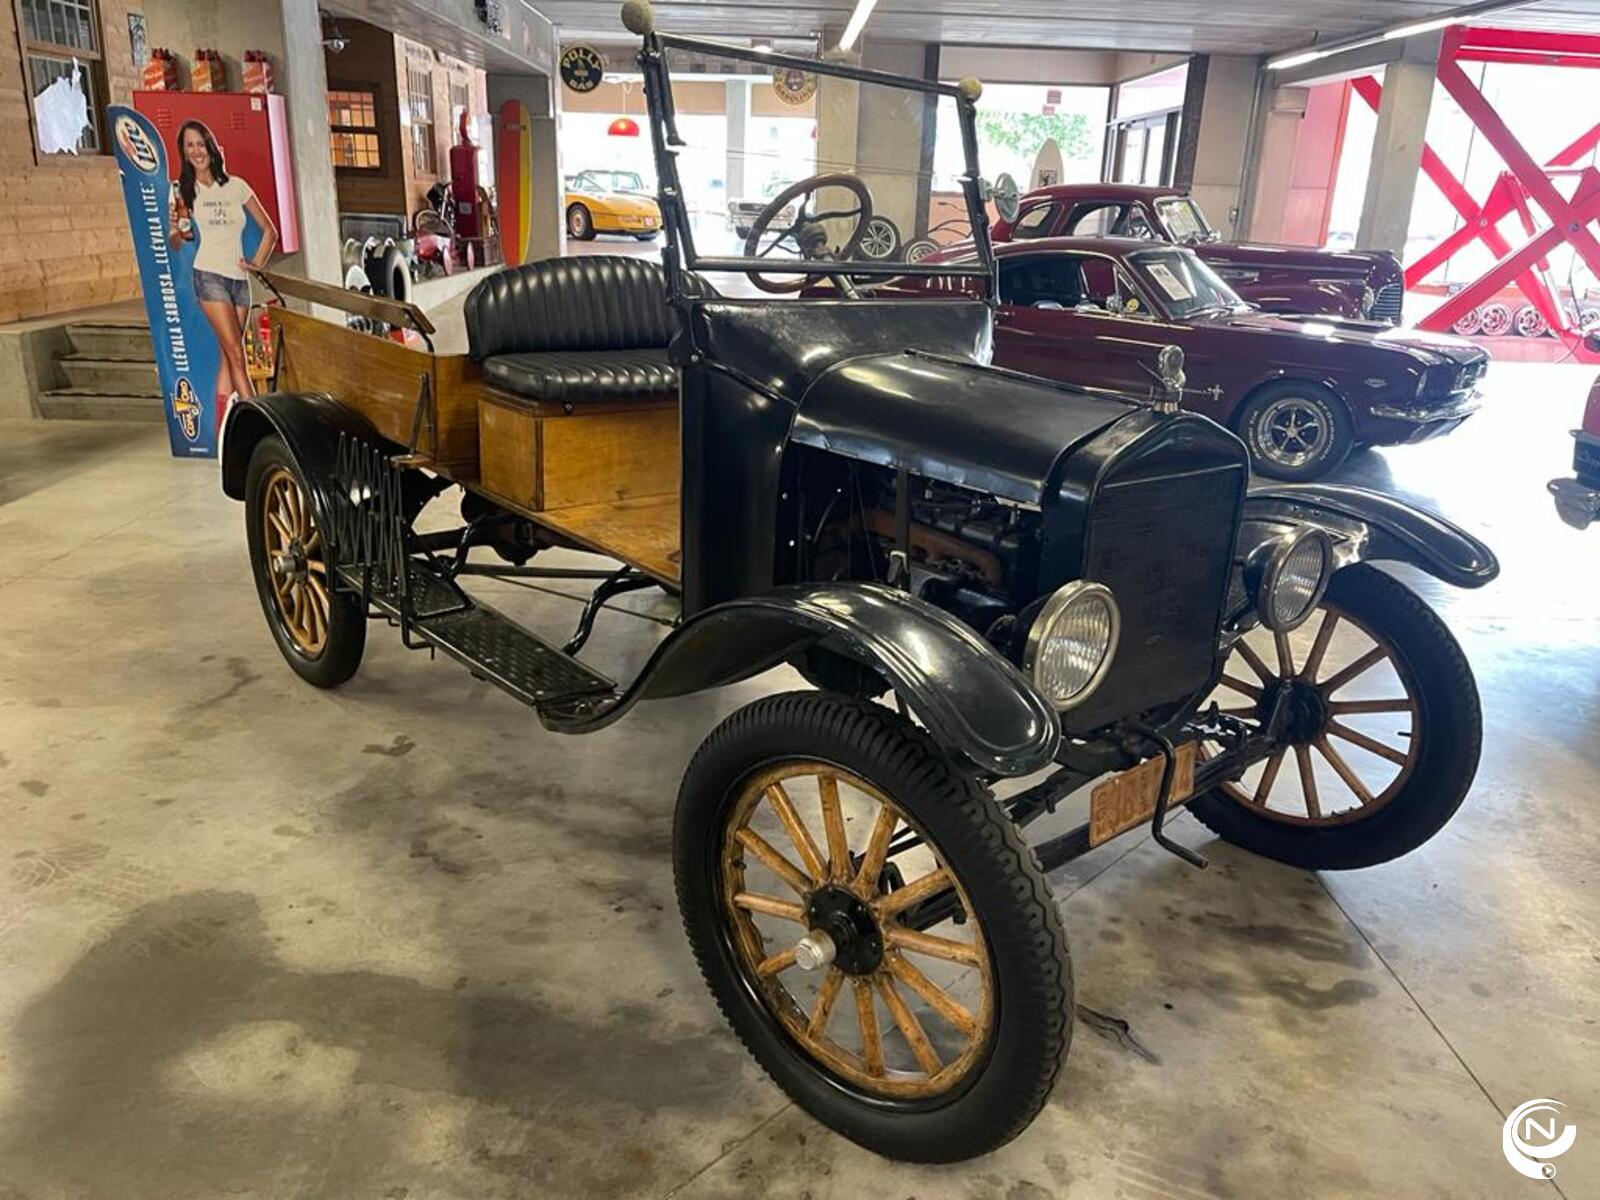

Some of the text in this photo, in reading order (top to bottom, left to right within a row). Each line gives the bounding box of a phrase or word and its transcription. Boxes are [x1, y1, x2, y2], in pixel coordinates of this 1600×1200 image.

[562, 49, 601, 71] POLLY
[570, 79, 594, 90] GAS
[168, 327, 190, 371] LLÉVALA
